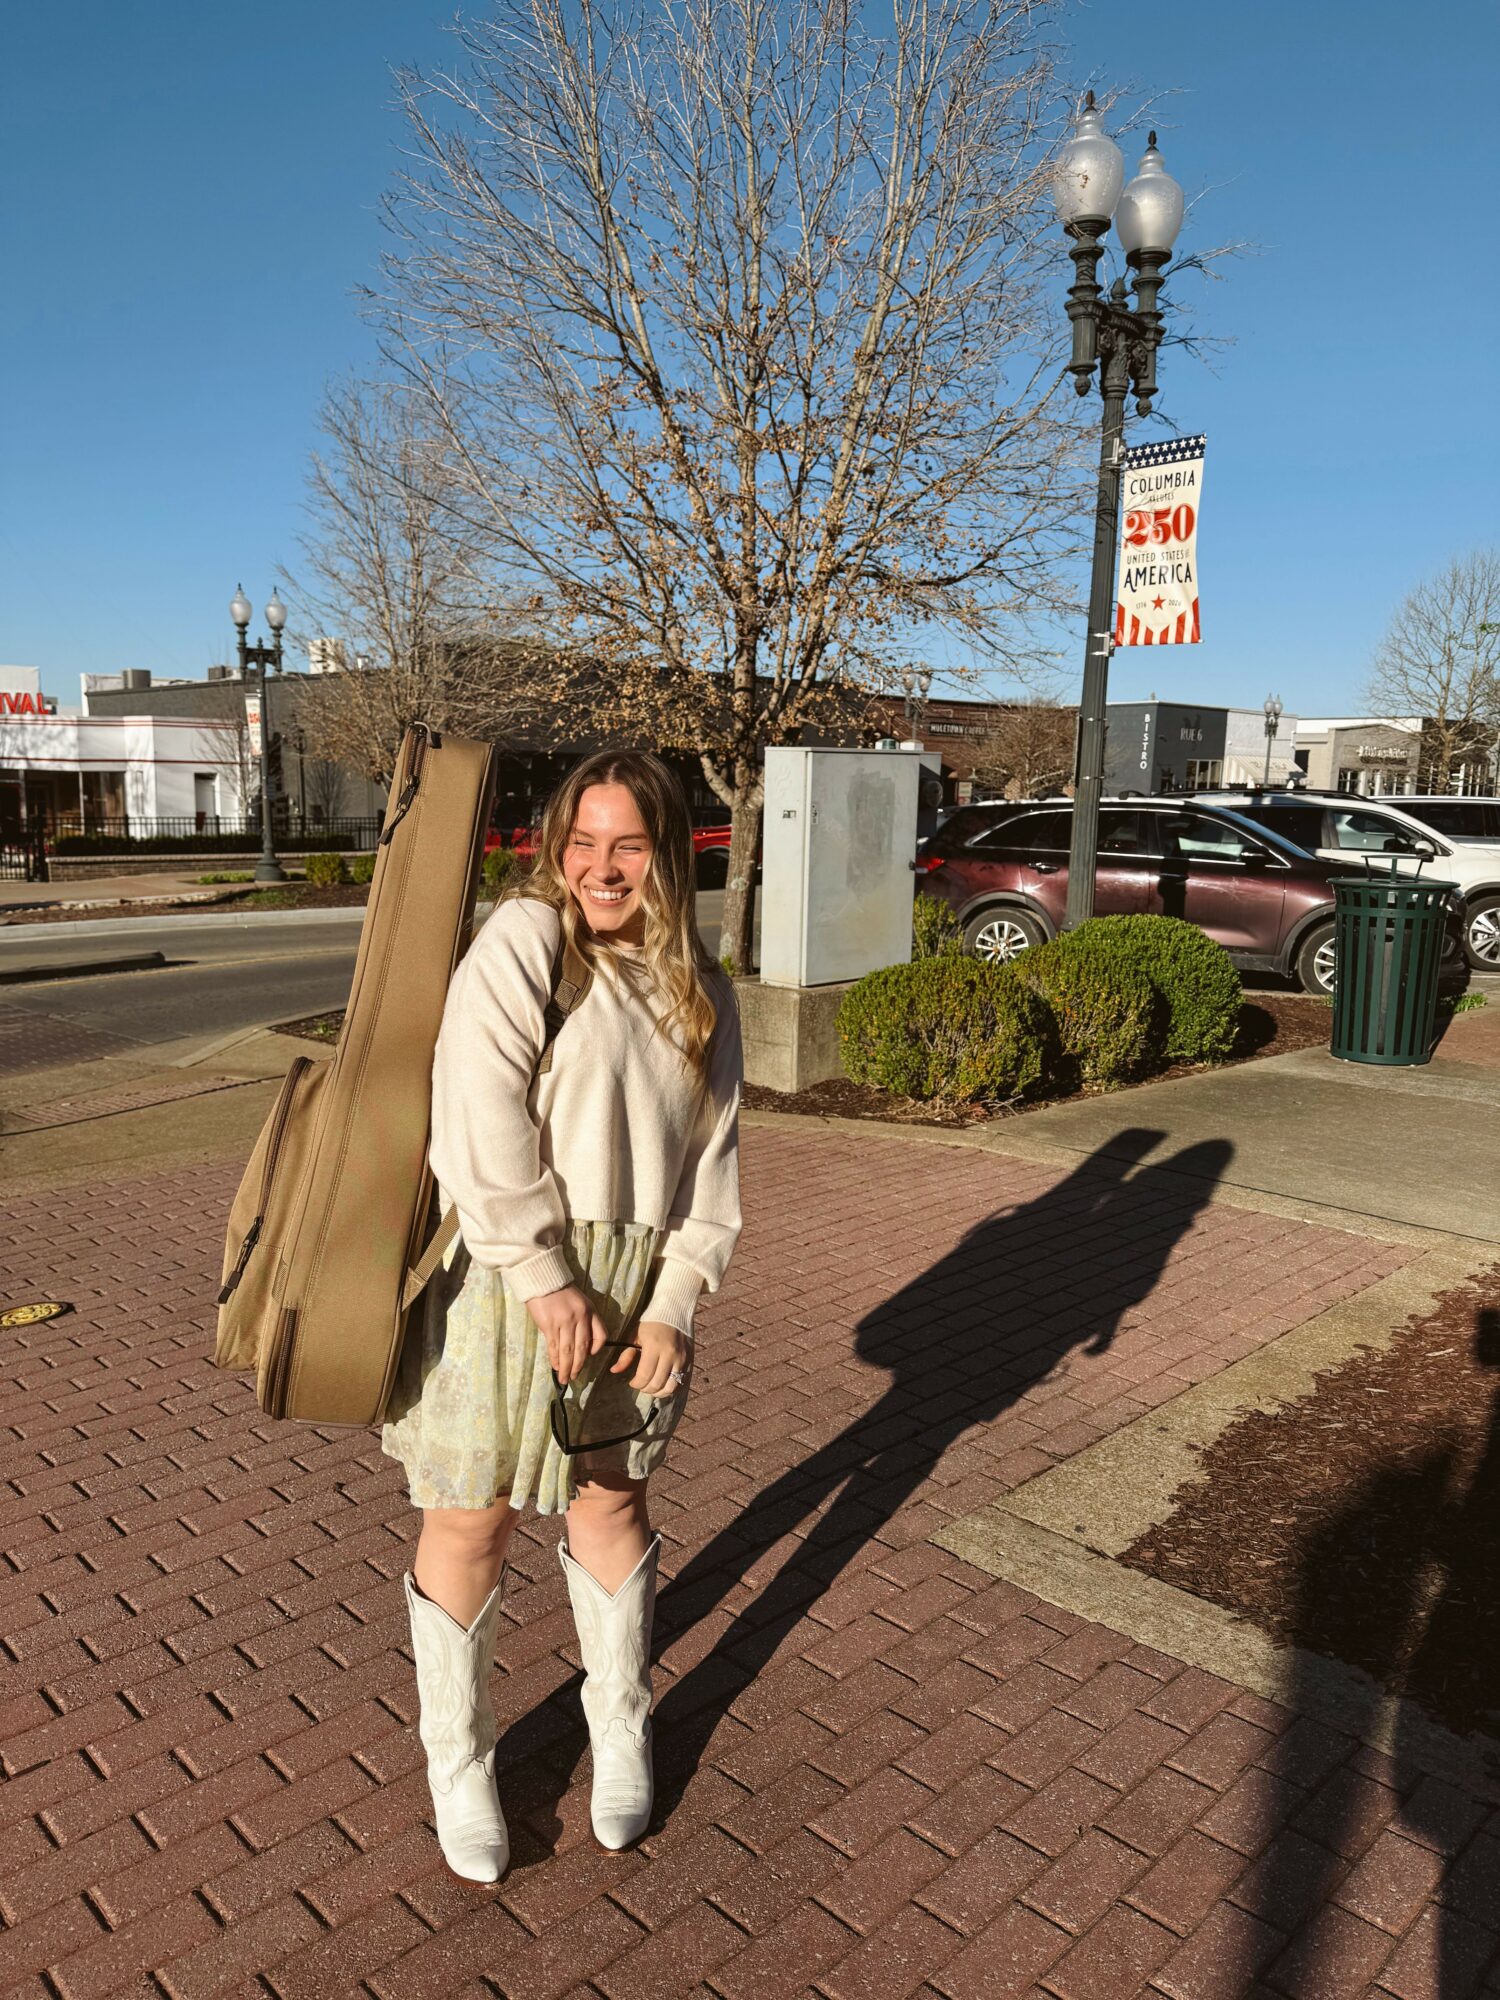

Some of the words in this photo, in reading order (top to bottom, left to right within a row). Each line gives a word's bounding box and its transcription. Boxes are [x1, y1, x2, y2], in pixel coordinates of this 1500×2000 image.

[1130, 470, 1195, 495] COLUMBIA
[1124, 503, 1195, 548] 250
[1127, 552, 1156, 564] UNITED
[1160, 549, 1184, 561] STATES
[1124, 562, 1192, 592] AMERICA
[930, 723, 963, 735] MULETOWN
[1140, 713, 1151, 770] BISTRO
[1180, 728, 1196, 741] RUE
[1197, 729, 1203, 741] 6
